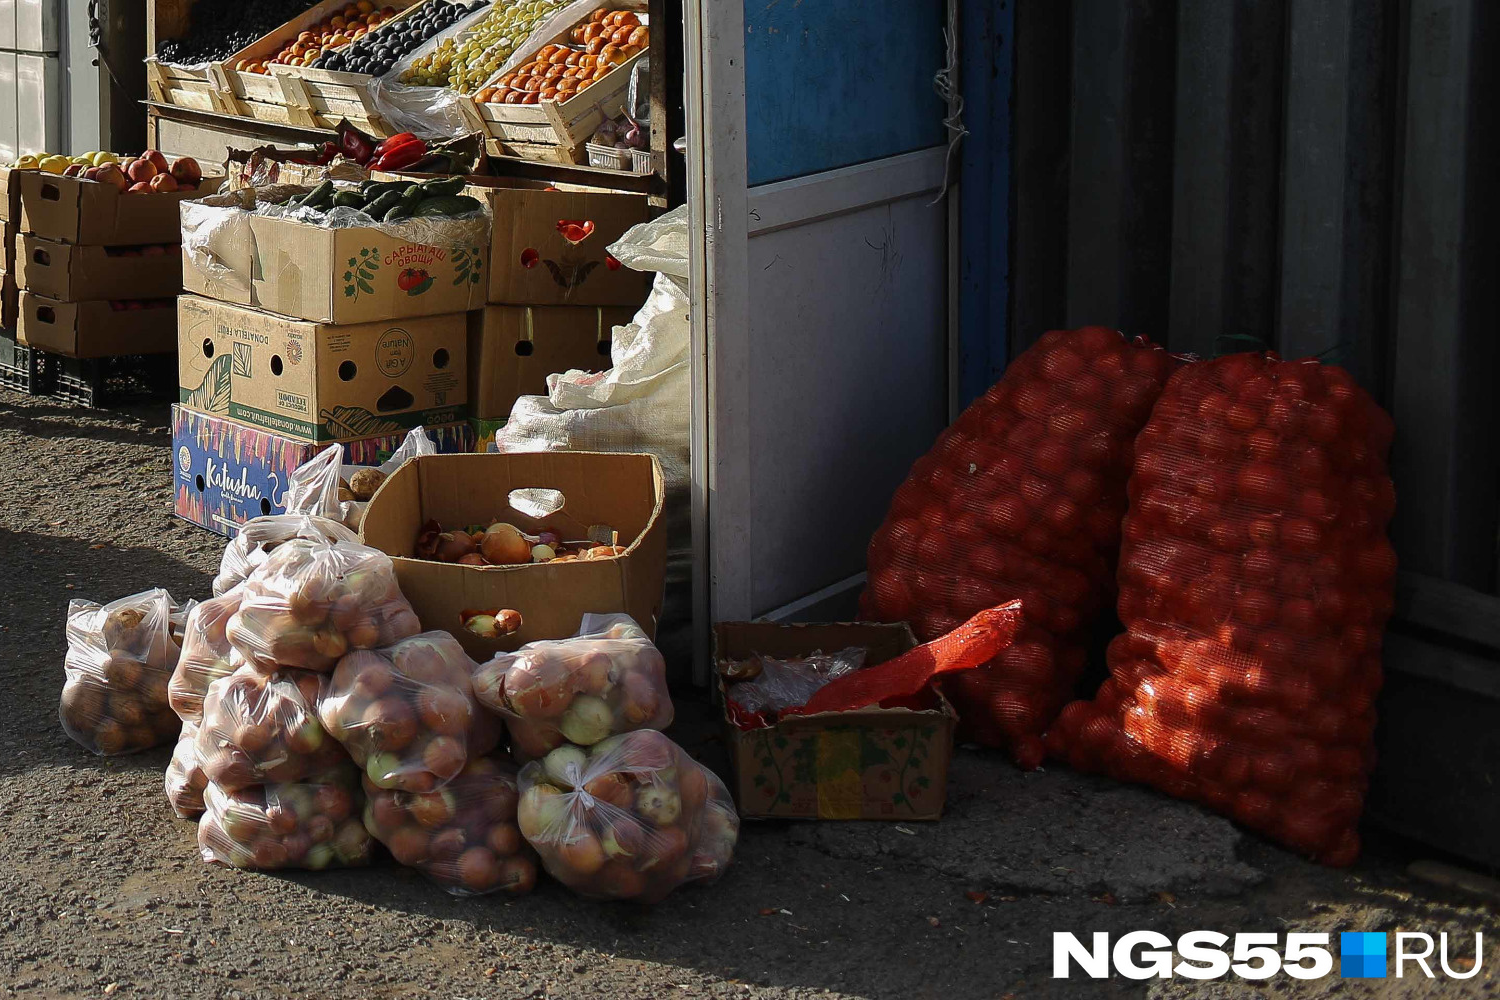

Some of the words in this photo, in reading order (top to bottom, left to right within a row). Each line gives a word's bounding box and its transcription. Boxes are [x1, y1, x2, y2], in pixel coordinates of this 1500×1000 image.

[397, 254, 433, 267] ОВОЩИ
[233, 327, 269, 345] DONATELLA
[382, 338, 409, 349] Nature
[236, 407, 313, 435] www.donatellafruit.com
[206, 457, 261, 501] Katusha
